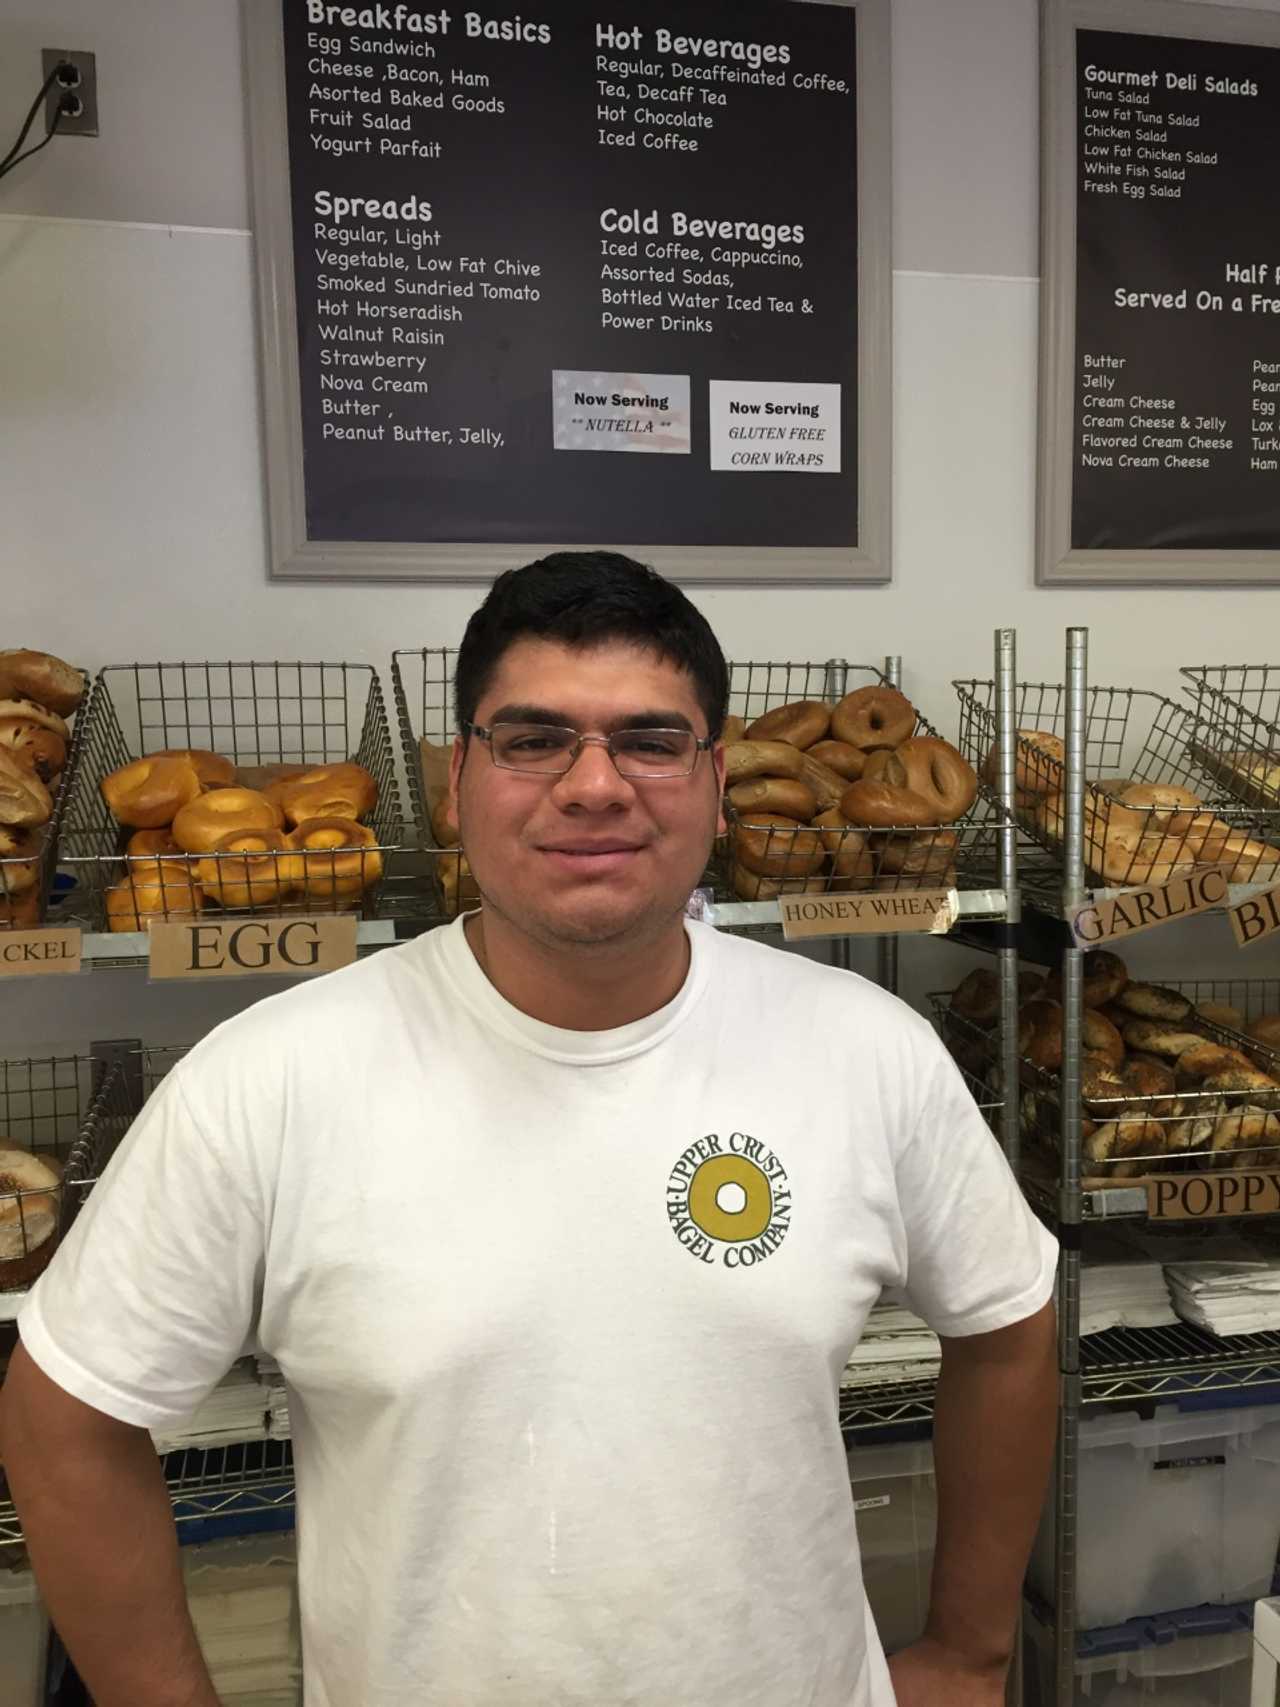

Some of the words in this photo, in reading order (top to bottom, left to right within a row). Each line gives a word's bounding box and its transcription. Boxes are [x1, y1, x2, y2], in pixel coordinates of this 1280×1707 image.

[307, 0, 451, 35] Breakfast
[465, 12, 550, 43] Basics
[308, 33, 341, 55] Egg
[350, 36, 435, 57] Sandwich
[596, 23, 642, 50] Hot
[655, 29, 790, 69] Beverages
[308, 58, 373, 78] Cheese
[452, 69, 489, 86] Ham
[596, 55, 664, 78] Regular,
[672, 62, 785, 86] Decaffeinated
[793, 73, 849, 93] Coffee,
[1085, 65, 1158, 86] Gourmet
[1166, 73, 1196, 90] Deli
[1205, 77, 1257, 96] Salads
[309, 83, 381, 103] Asorted
[390, 89, 443, 108] Baked
[452, 95, 504, 113] Goods
[597, 80, 630, 99] Tea,
[638, 84, 694, 102] Decaff
[700, 89, 726, 105] Tea
[1085, 87, 1112, 100] Tuna
[1118, 91, 1149, 104] Salad
[310, 109, 353, 126] Fruit
[363, 113, 410, 130] Salad
[598, 105, 626, 121] Hot
[635, 108, 712, 128] Chocolate
[1085, 106, 1109, 118] Low
[1114, 108, 1130, 120] Fat
[1136, 111, 1162, 124] Tuna
[1168, 114, 1199, 126] Salad
[599, 129, 635, 146] Iced
[643, 133, 698, 151] Coffee
[1085, 125, 1130, 138] Chicken
[1136, 129, 1167, 142] Salad
[311, 134, 371, 156] Yogurt
[380, 139, 441, 157] Parfait
[1085, 144, 1109, 155] Low
[1114, 145, 1131, 157] Fat
[1137, 147, 1181, 161] Chicken
[1186, 151, 1217, 164] Salad
[1085, 162, 1121, 174] White
[1127, 164, 1149, 176] Fish
[1154, 167, 1185, 180] Salad
[1085, 180, 1117, 193] Fresh
[1123, 182, 1144, 198] Egg
[1150, 184, 1181, 197] Salad
[315, 191, 432, 224] Spreads
[315, 223, 387, 246] Regular,
[396, 229, 440, 250] Light
[601, 209, 658, 234] Cold
[671, 212, 804, 249] Beverages
[315, 249, 408, 271] Vegetable,
[418, 255, 452, 271] Low
[460, 258, 486, 273] Fat
[495, 260, 540, 276] Chive
[601, 240, 637, 256] Iced
[646, 243, 703, 262] Coffee,
[711, 247, 803, 268] Cappuccino,
[601, 264, 674, 282] Assorted
[683, 269, 733, 287] Sodas,
[1227, 264, 1267, 283] Half
[318, 275, 385, 292] Smoked
[395, 279, 473, 297] Sundried
[480, 283, 540, 301] Tomato
[318, 299, 348, 315] Hot
[357, 301, 462, 320] Horseradish
[602, 288, 661, 306] Bottled
[668, 292, 719, 308] Water
[727, 295, 761, 311] Iced
[768, 298, 793, 312] Tea
[802, 299, 813, 313] &
[1115, 288, 1186, 308] Served
[1197, 291, 1222, 310] On
[1232, 298, 1242, 311] a
[602, 312, 654, 329] Power
[661, 316, 712, 332] Drinks
[319, 324, 383, 341] Walnut
[392, 327, 443, 344] Raisin
[321, 350, 426, 372] Strawberry
[1084, 355, 1126, 368] Butter
[321, 374, 363, 390] Nova
[372, 377, 427, 392] Cream
[1083, 375, 1114, 391] Jelly
[322, 399, 380, 415] Butter
[575, 393, 607, 405] Now
[612, 394, 668, 410] Serving
[730, 402, 761, 414] Now
[765, 403, 819, 418] Serving
[1083, 395, 1124, 407] Cream
[1130, 396, 1175, 409] Cheese
[1253, 399, 1275, 415] Egg
[586, 419, 653, 432] NUTELLA
[729, 427, 784, 439] GLUTEN
[790, 428, 826, 440] FREE
[1083, 415, 1124, 427] Cream
[1130, 416, 1174, 428] Cheese
[1181, 416, 1190, 428] &
[1195, 417, 1226, 432] Jelly
[1252, 419, 1273, 431] Lox
[323, 423, 384, 440] Peanut
[394, 426, 452, 444] Butter,
[460, 428, 504, 448] Jelly,
[1083, 434, 1137, 447] Flavored
[1143, 435, 1182, 448] Cream
[1188, 436, 1232, 449] Cheese
[1252, 438, 1280, 450] Turk
[732, 453, 770, 464] CORN
[776, 452, 823, 465] WRAPS
[1083, 454, 1113, 466] Nova
[1119, 455, 1159, 467] Cream
[1165, 455, 1209, 467] Cheese
[1251, 458, 1277, 469] Ham
[785, 901, 865, 921] HONEY
[1073, 869, 1226, 941] GARLIC
[185, 922, 322, 971] EGG
[666, 1133, 723, 1195] UPPER
[729, 1131, 788, 1182] CRUST
[666, 1200, 716, 1264] BAGEL
[722, 1189, 792, 1268] COMPANY
